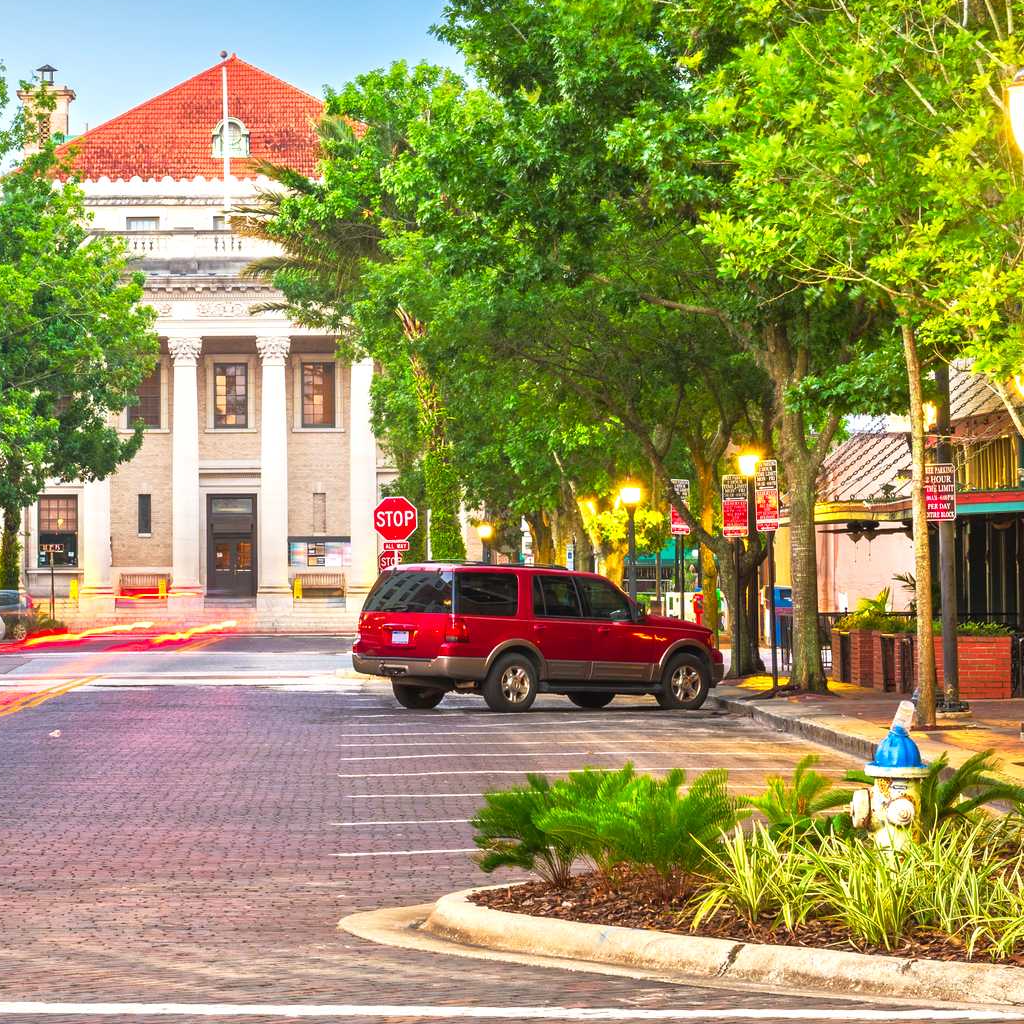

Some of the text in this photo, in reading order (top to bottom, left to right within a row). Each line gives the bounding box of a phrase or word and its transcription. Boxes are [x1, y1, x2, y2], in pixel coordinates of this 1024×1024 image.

[935, 466, 954, 474] PARKING
[930, 475, 951, 483] HOUR
[938, 484, 954, 492] LIMIT
[376, 511, 414, 527] STOP
